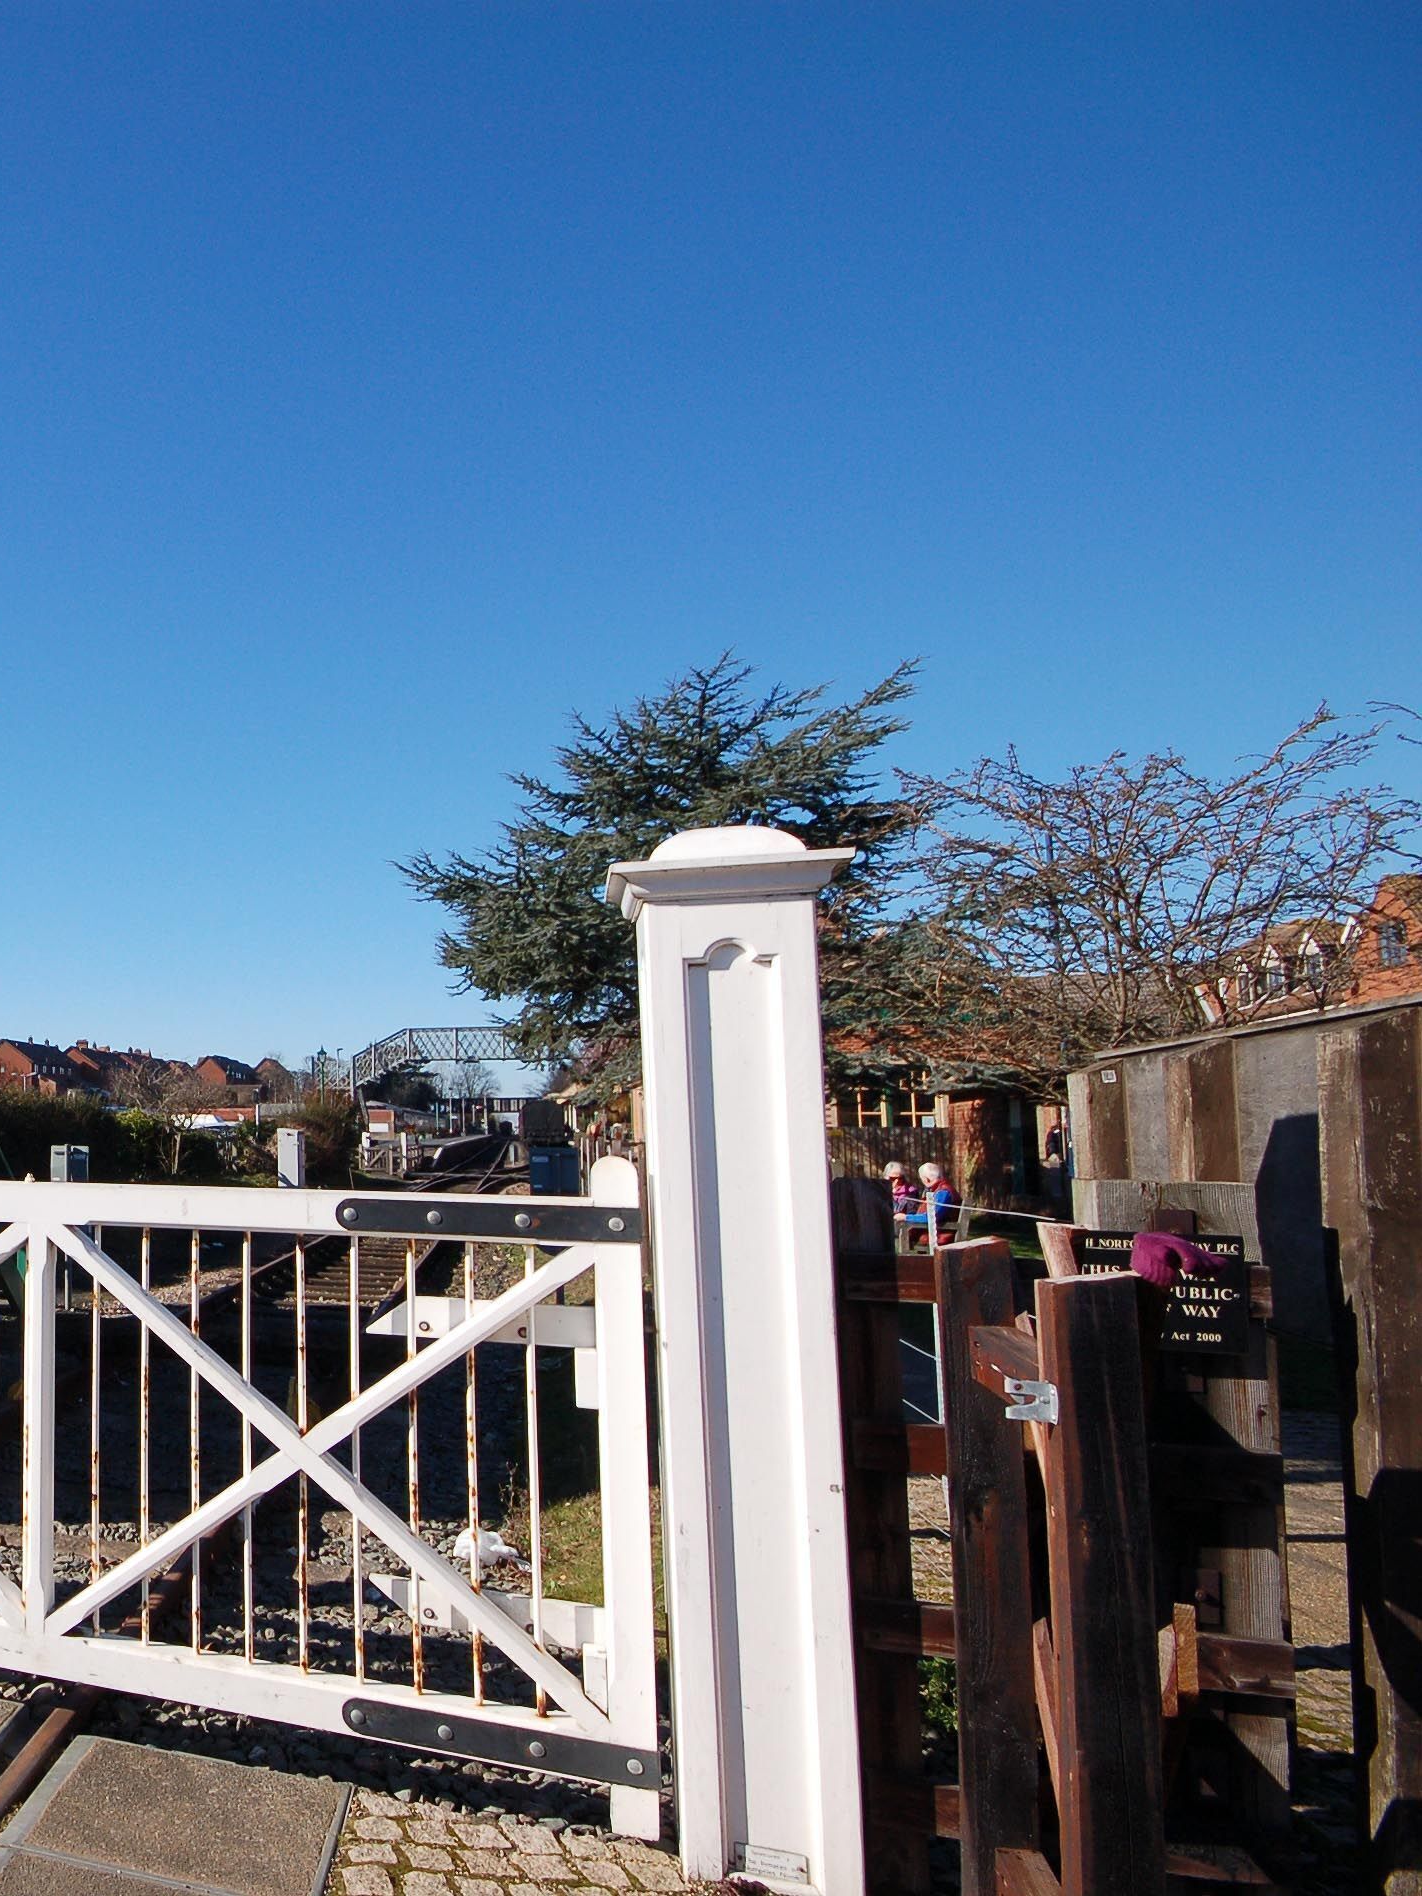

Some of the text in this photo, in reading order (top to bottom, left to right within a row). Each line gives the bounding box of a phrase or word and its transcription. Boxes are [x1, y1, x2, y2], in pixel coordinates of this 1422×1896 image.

[1216, 1243, 1240, 1253] PLC
[1169, 1286, 1233, 1301] UBLIC
[1181, 1304, 1221, 1319] WAY
[1171, 1331, 1190, 1341] Act
[1196, 1332, 1222, 1342] 2000
